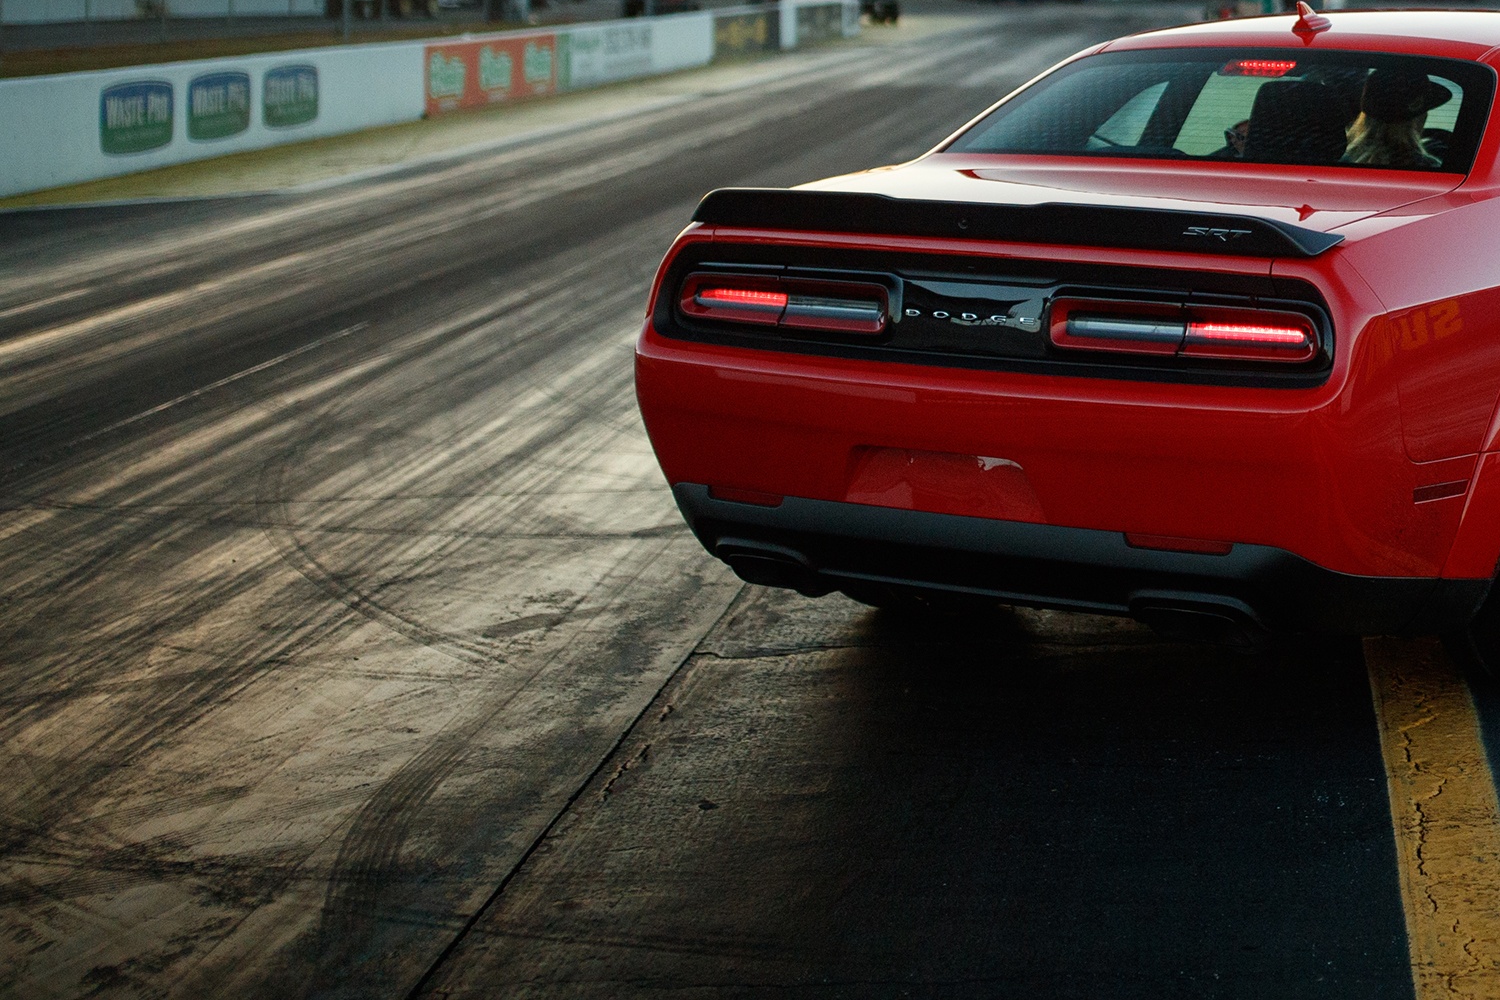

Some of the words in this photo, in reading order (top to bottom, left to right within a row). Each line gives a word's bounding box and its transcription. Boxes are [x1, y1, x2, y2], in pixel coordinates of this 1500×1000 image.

[106, 96, 145, 129] WASTE
[1183, 226, 1252, 241] SRT
[905, 308, 1036, 325] DODGE
